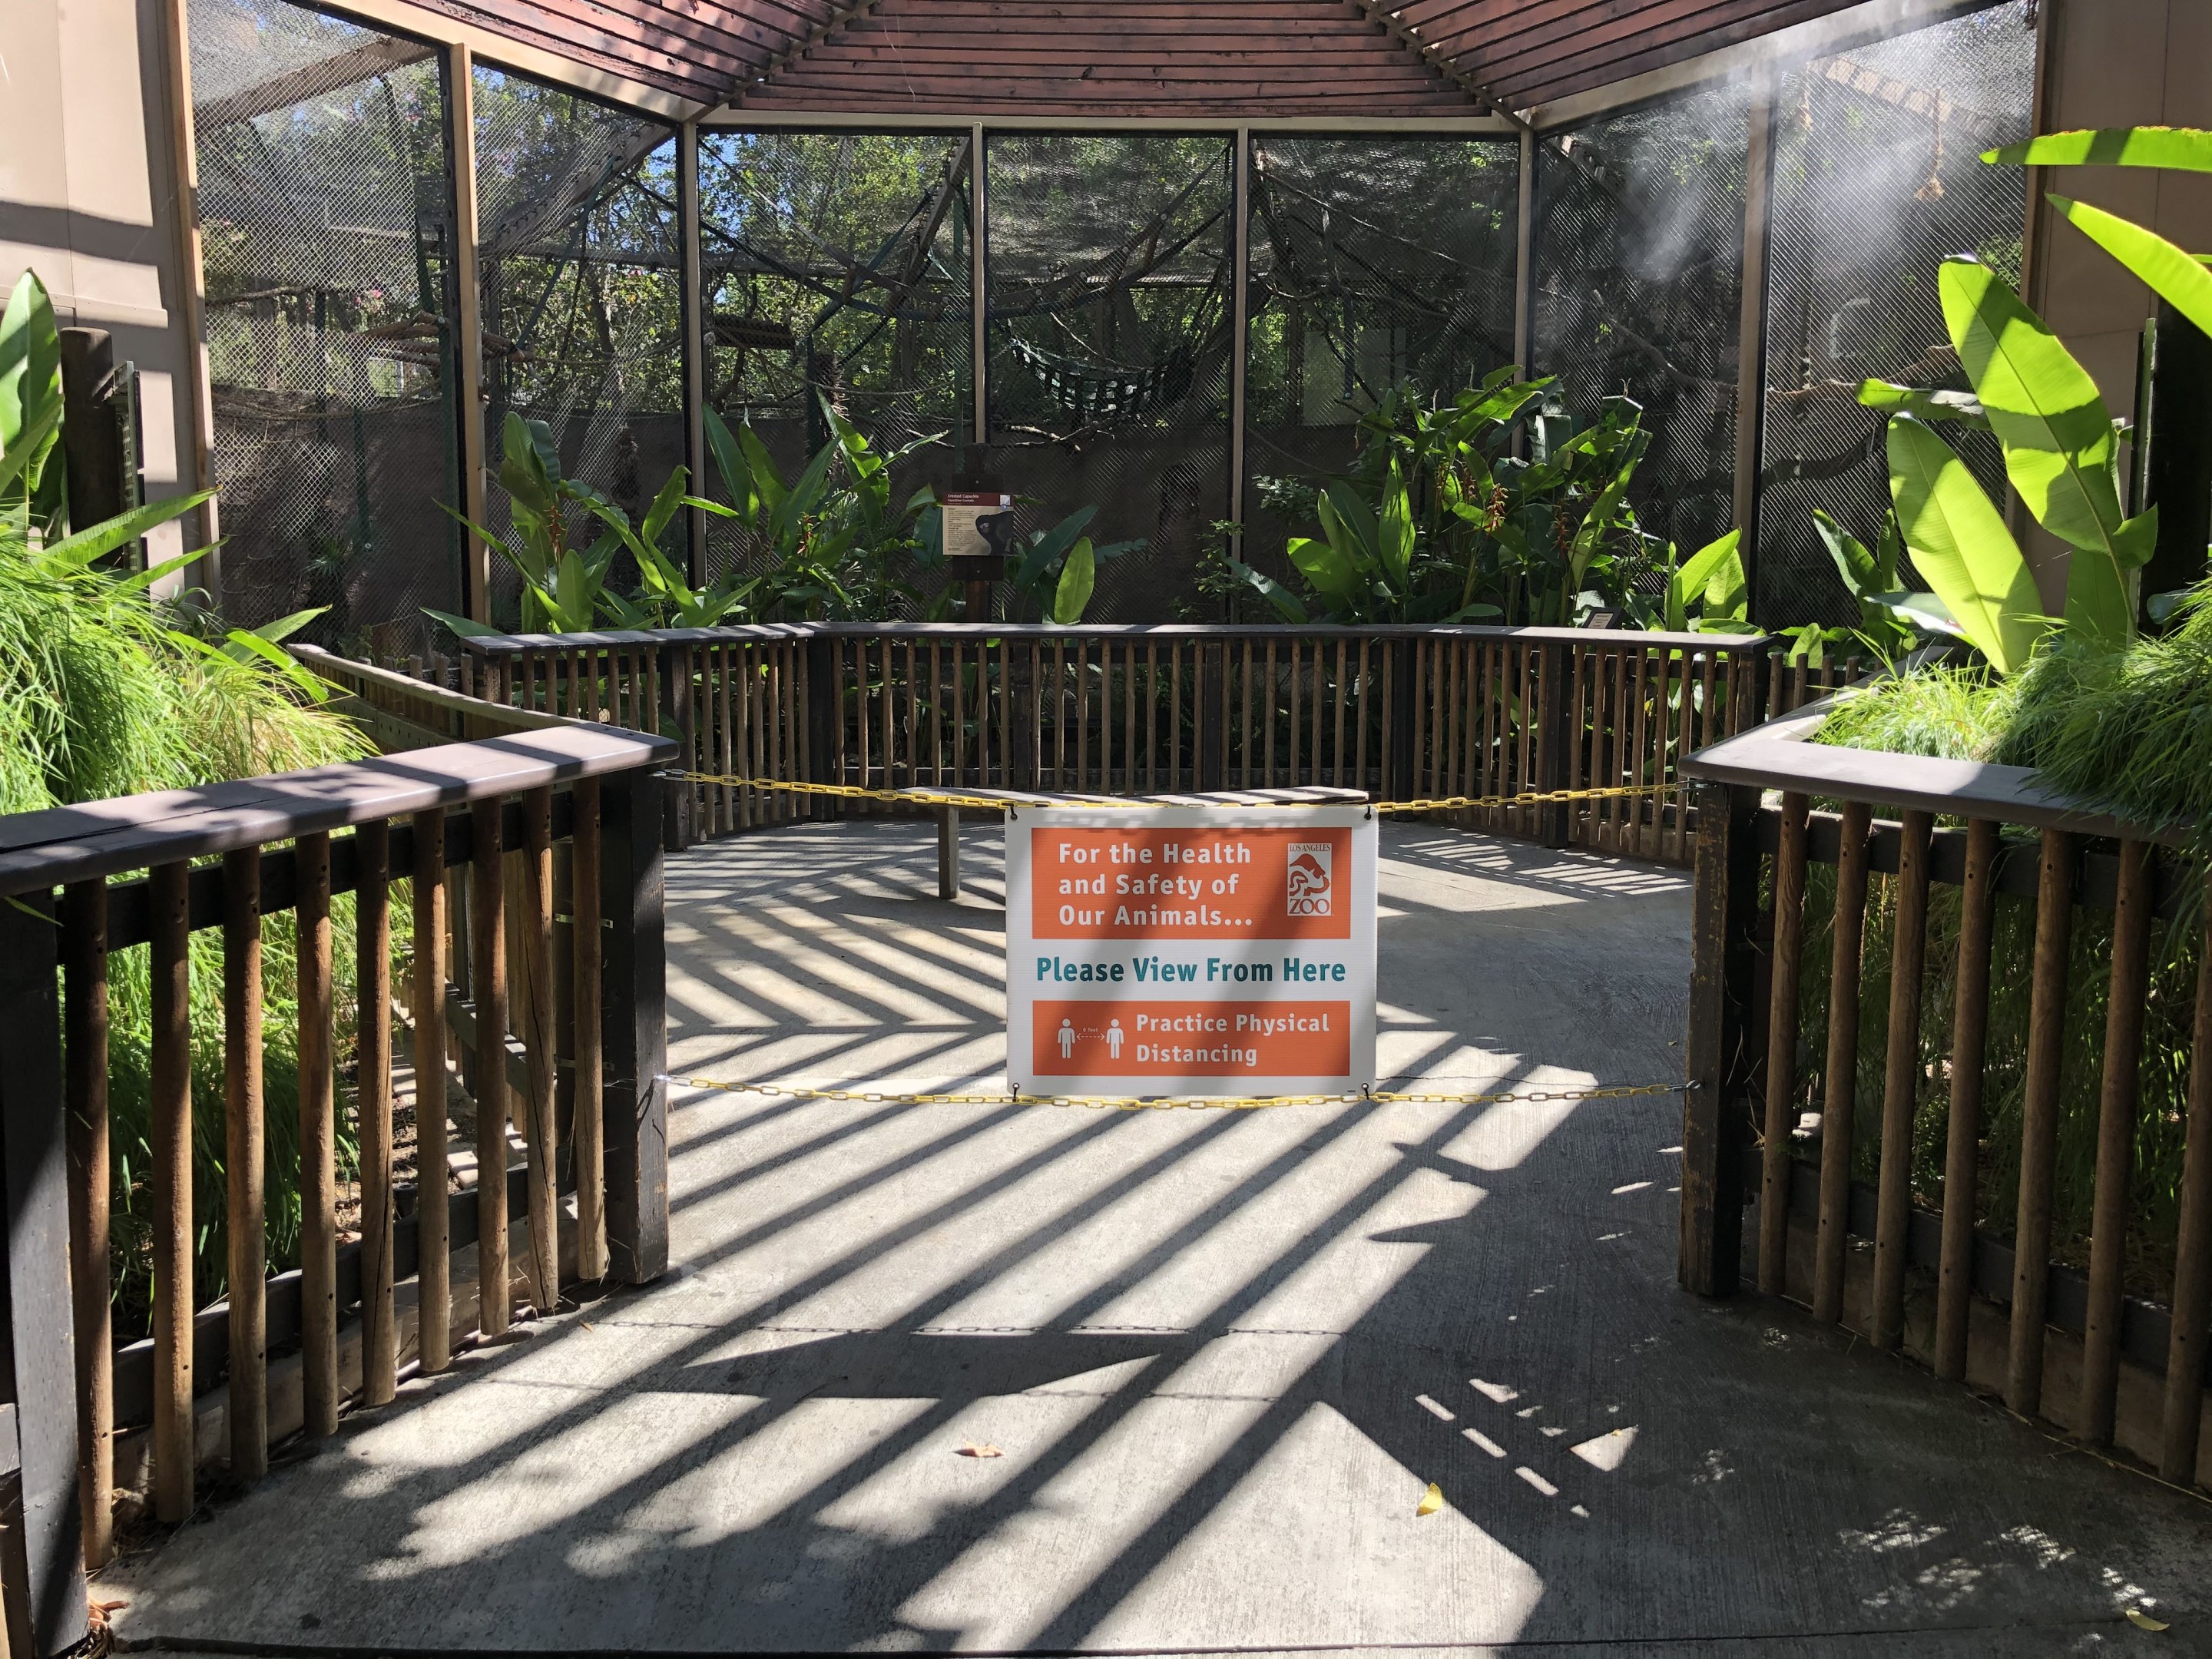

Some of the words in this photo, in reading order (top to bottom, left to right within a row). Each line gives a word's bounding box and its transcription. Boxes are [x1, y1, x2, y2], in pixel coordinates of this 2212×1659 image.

[1059, 843, 1100, 863] For
[1109, 843, 1153, 863] the
[1164, 843, 1250, 863] Health
[1058, 873, 1105, 895] and
[1116, 873, 1203, 900] Safety
[1211, 873, 1240, 895] of
[1059, 905, 1104, 926] Our
[1114, 904, 1253, 926] Animals...
[1289, 898, 1330, 914] ZOO
[1037, 956, 1124, 982] Please
[1132, 956, 1197, 982] View
[1207, 958, 1273, 982] From
[1283, 958, 1346, 982] Here
[1137, 1013, 1227, 1031] Practice
[1236, 1013, 1330, 1036] Physical
[1137, 1044, 1257, 1066] Distancing
